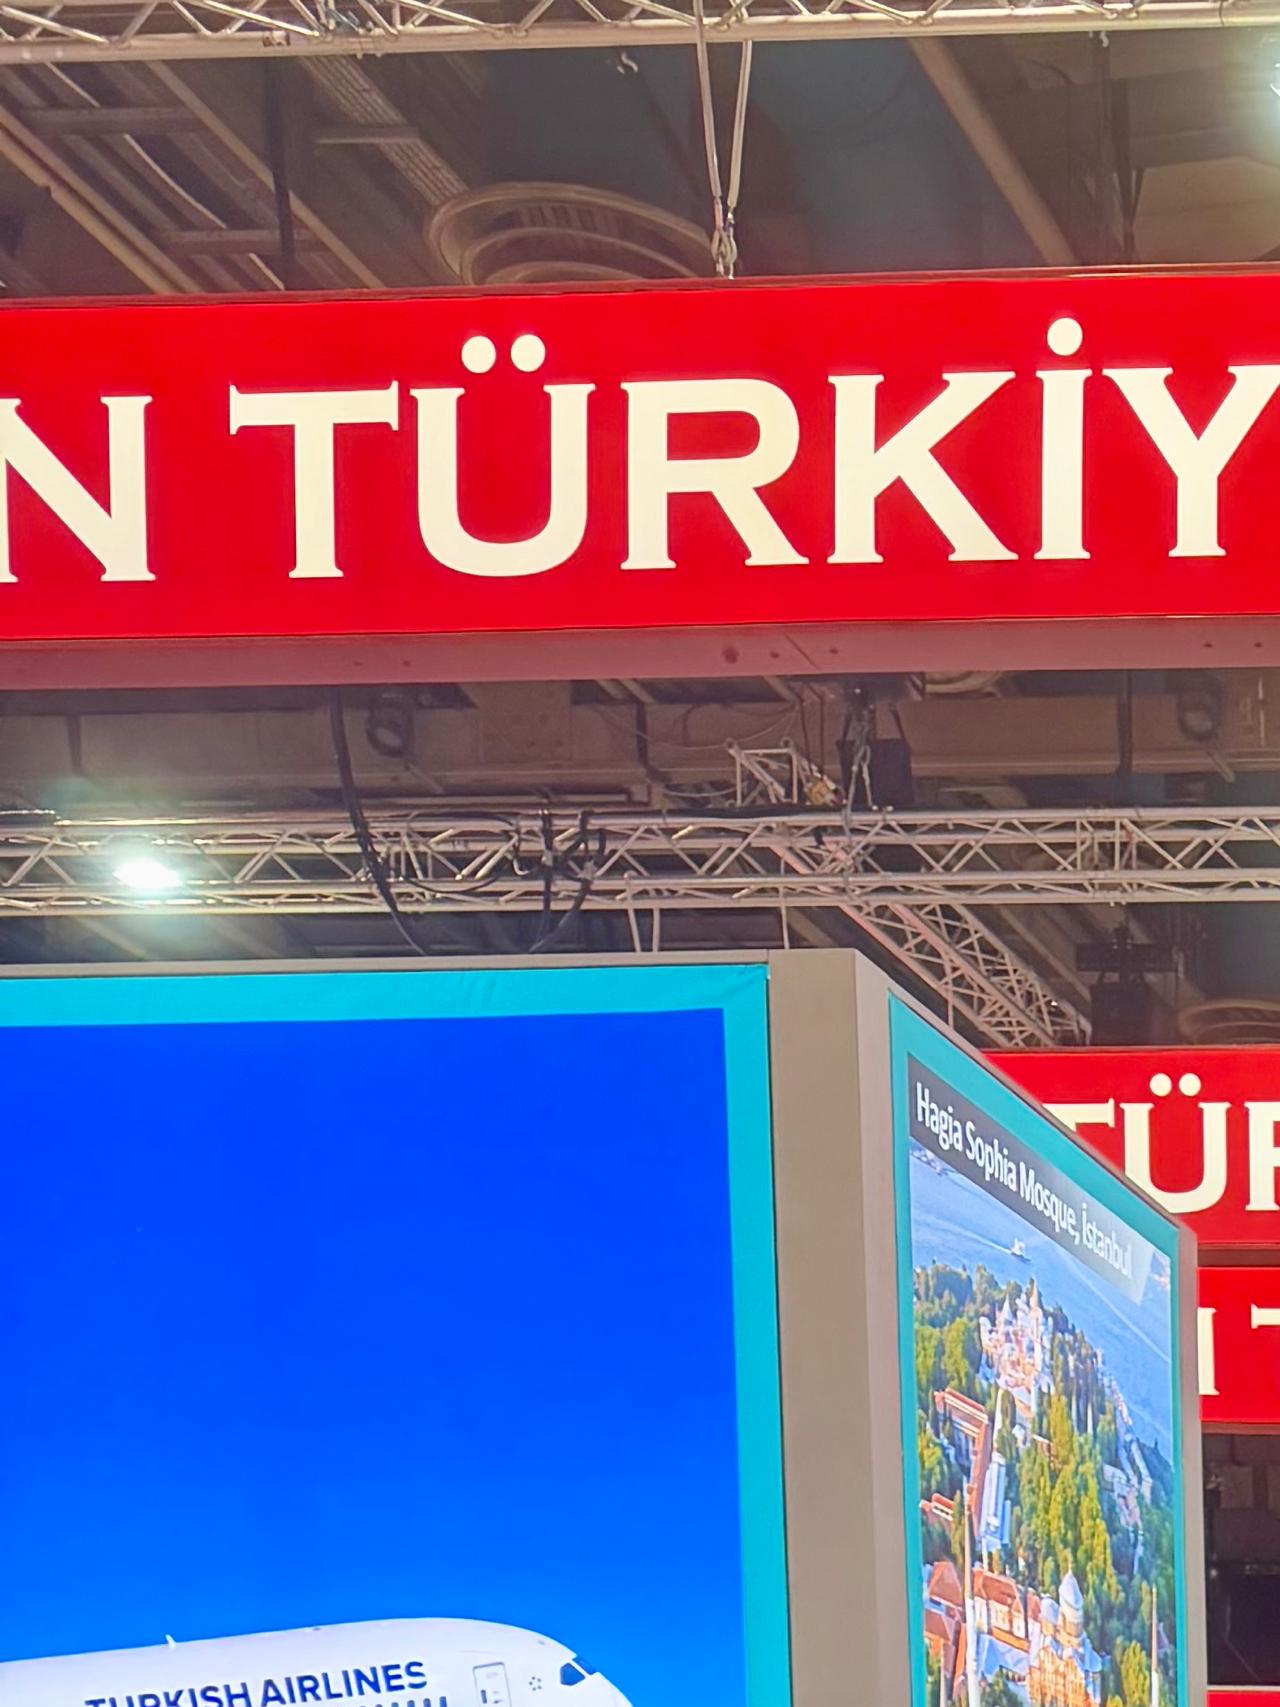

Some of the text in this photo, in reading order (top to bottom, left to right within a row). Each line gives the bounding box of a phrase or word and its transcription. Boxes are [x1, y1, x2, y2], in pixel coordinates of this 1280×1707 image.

[915, 1081, 1133, 1280] Hagia Sophia Mosque, İstanbul
